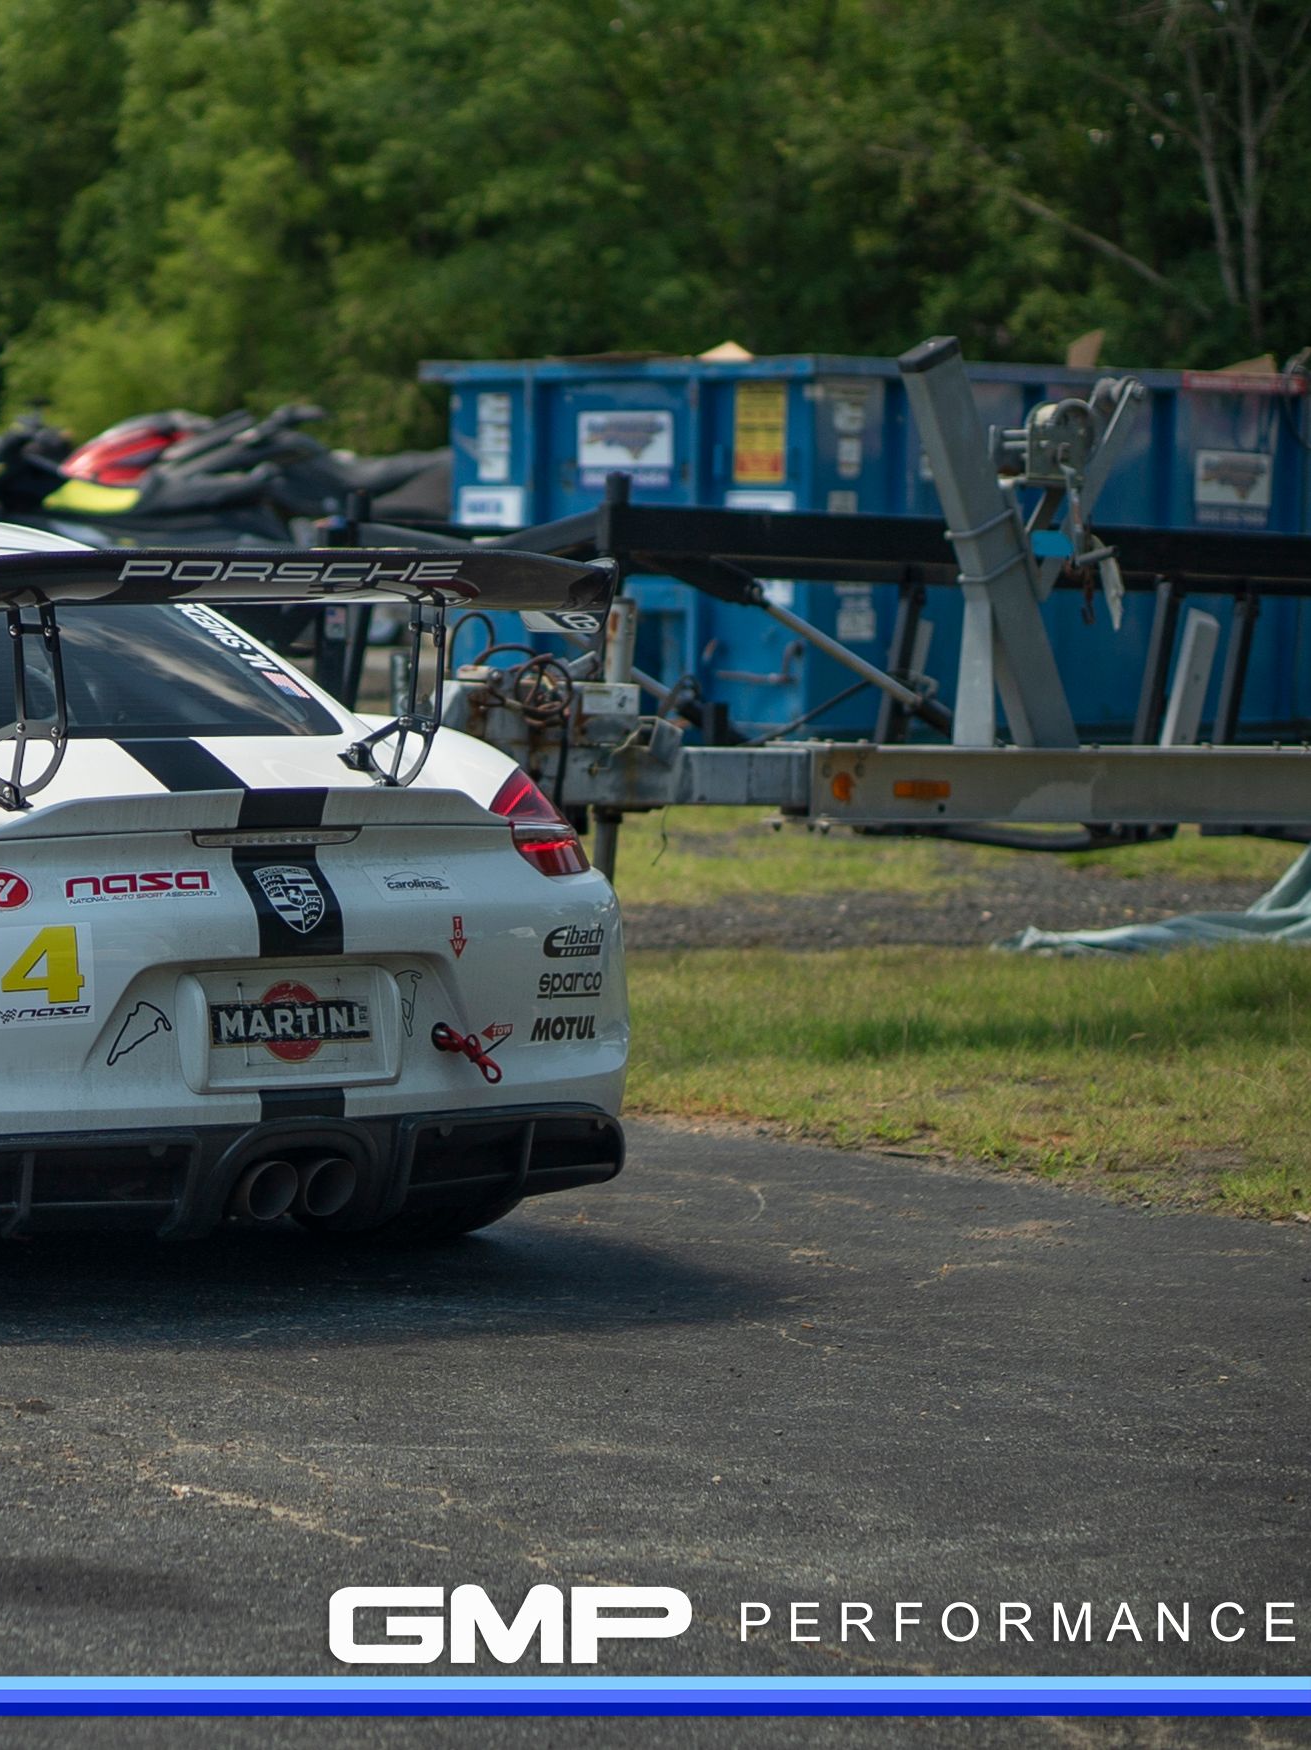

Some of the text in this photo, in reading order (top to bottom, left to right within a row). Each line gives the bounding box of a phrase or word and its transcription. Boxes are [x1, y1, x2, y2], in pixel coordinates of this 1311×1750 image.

[118, 560, 463, 582] PORSCHE
[65, 871, 210, 898] nasa
[387, 879, 443, 889] carolinas
[69, 895, 110, 905] NATIONAL
[165, 890, 218, 898] ASSOCIATION
[543, 923, 604, 958] Eibach
[0, 925, 85, 1004] 4
[539, 971, 603, 1000] sparco
[17, 1005, 92, 1018] nasa
[218, 1006, 364, 1044] MARTINI
[492, 1026, 513, 1036] TOW
[530, 1015, 596, 1041] MOTUL
